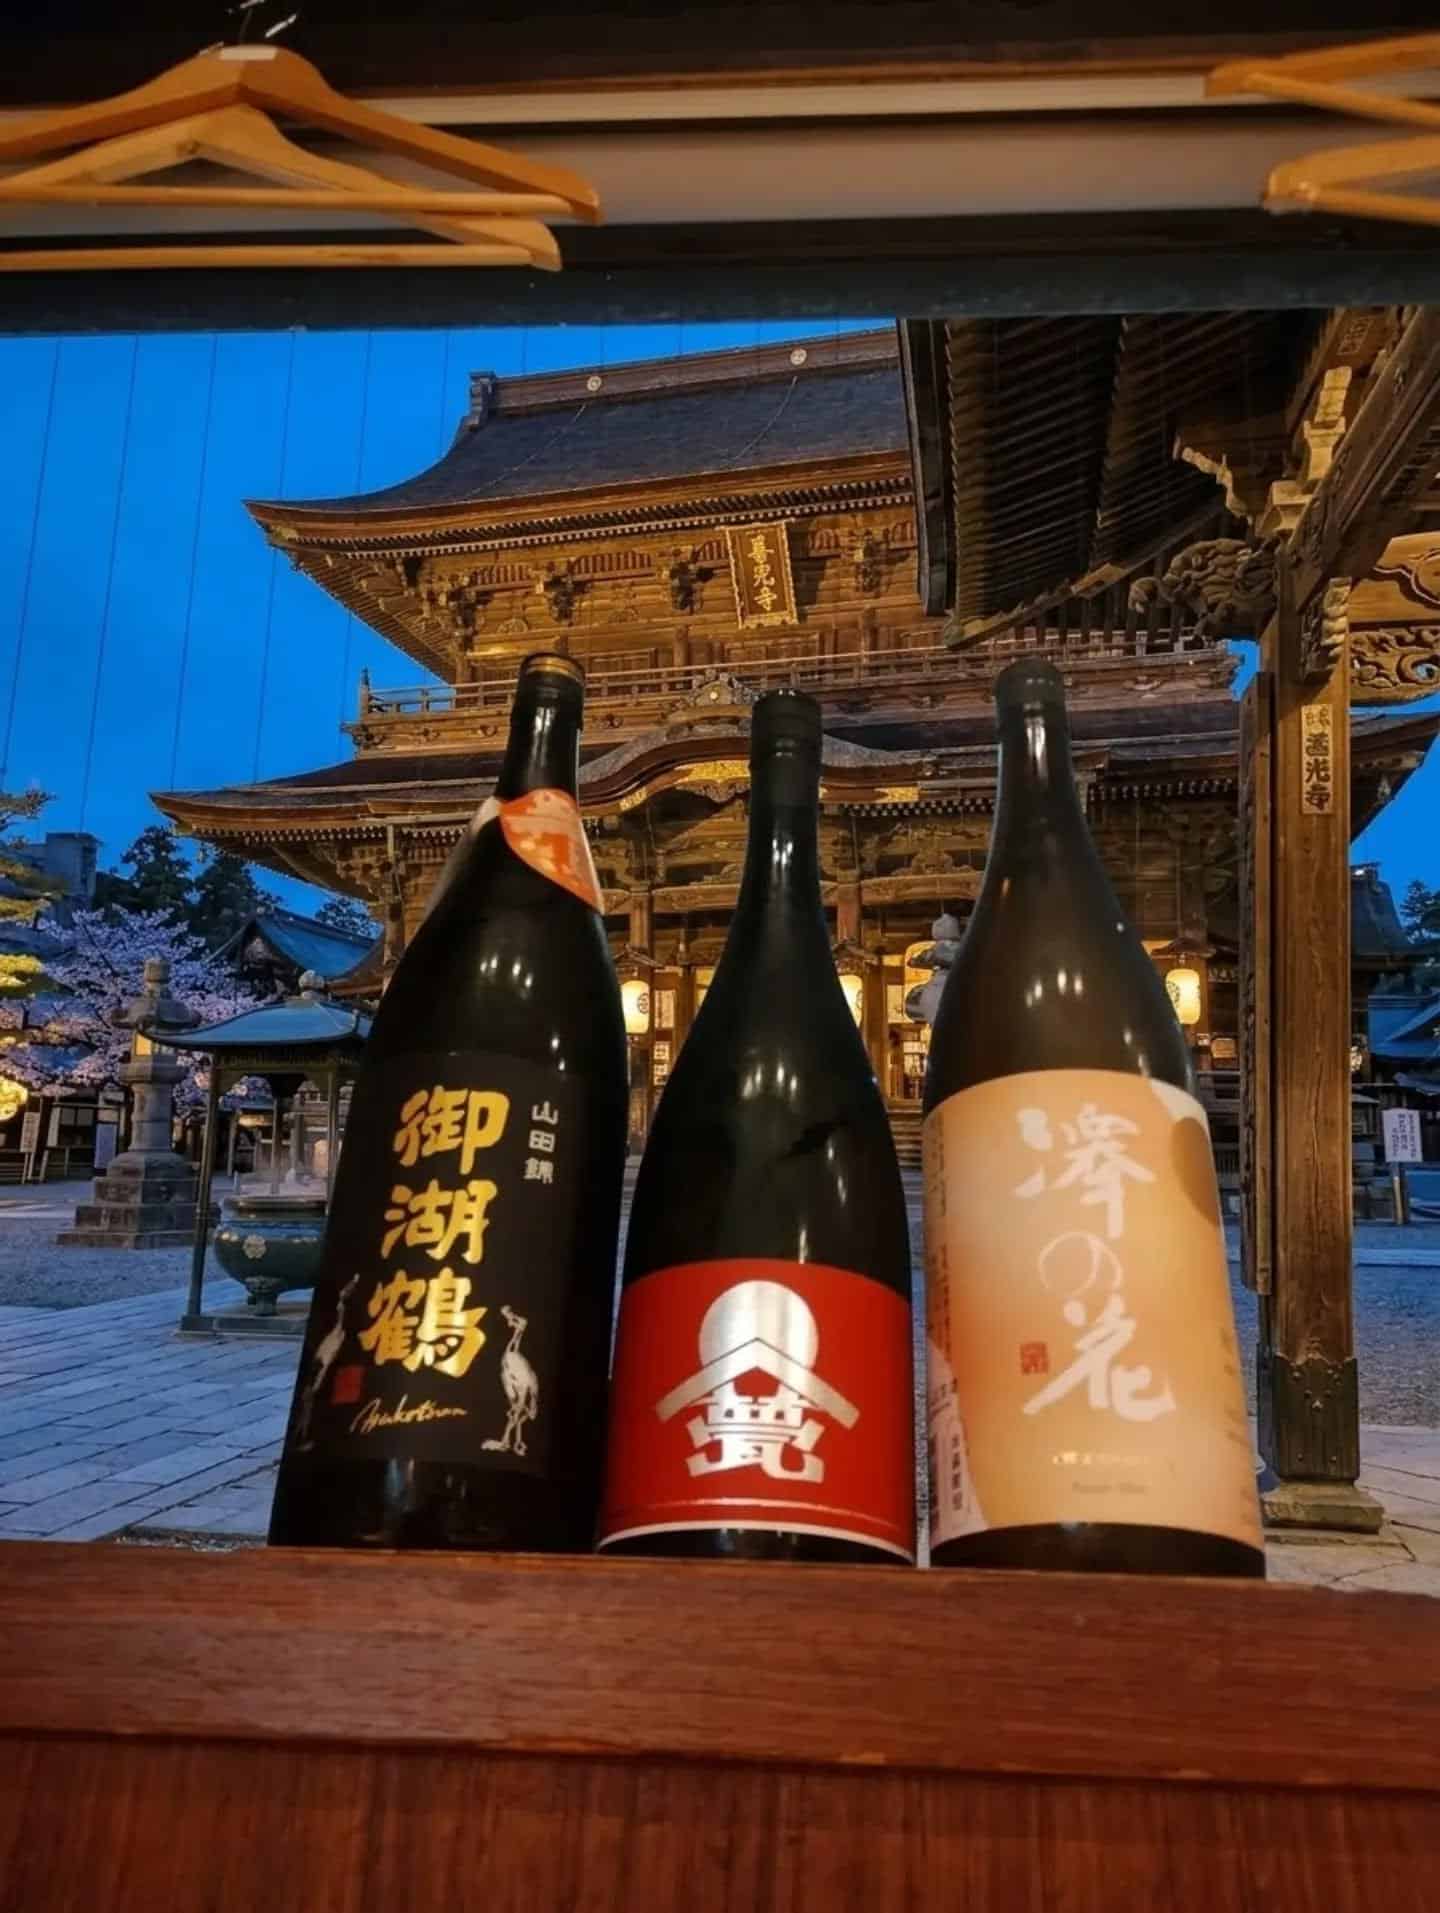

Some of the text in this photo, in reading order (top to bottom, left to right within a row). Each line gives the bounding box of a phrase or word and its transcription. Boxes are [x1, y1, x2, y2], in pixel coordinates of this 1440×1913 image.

[358, 1085, 511, 1379] 御湖鶴
[524, 1101, 559, 1184] 山田錦
[1014, 1104, 1177, 1423] 澤の花
